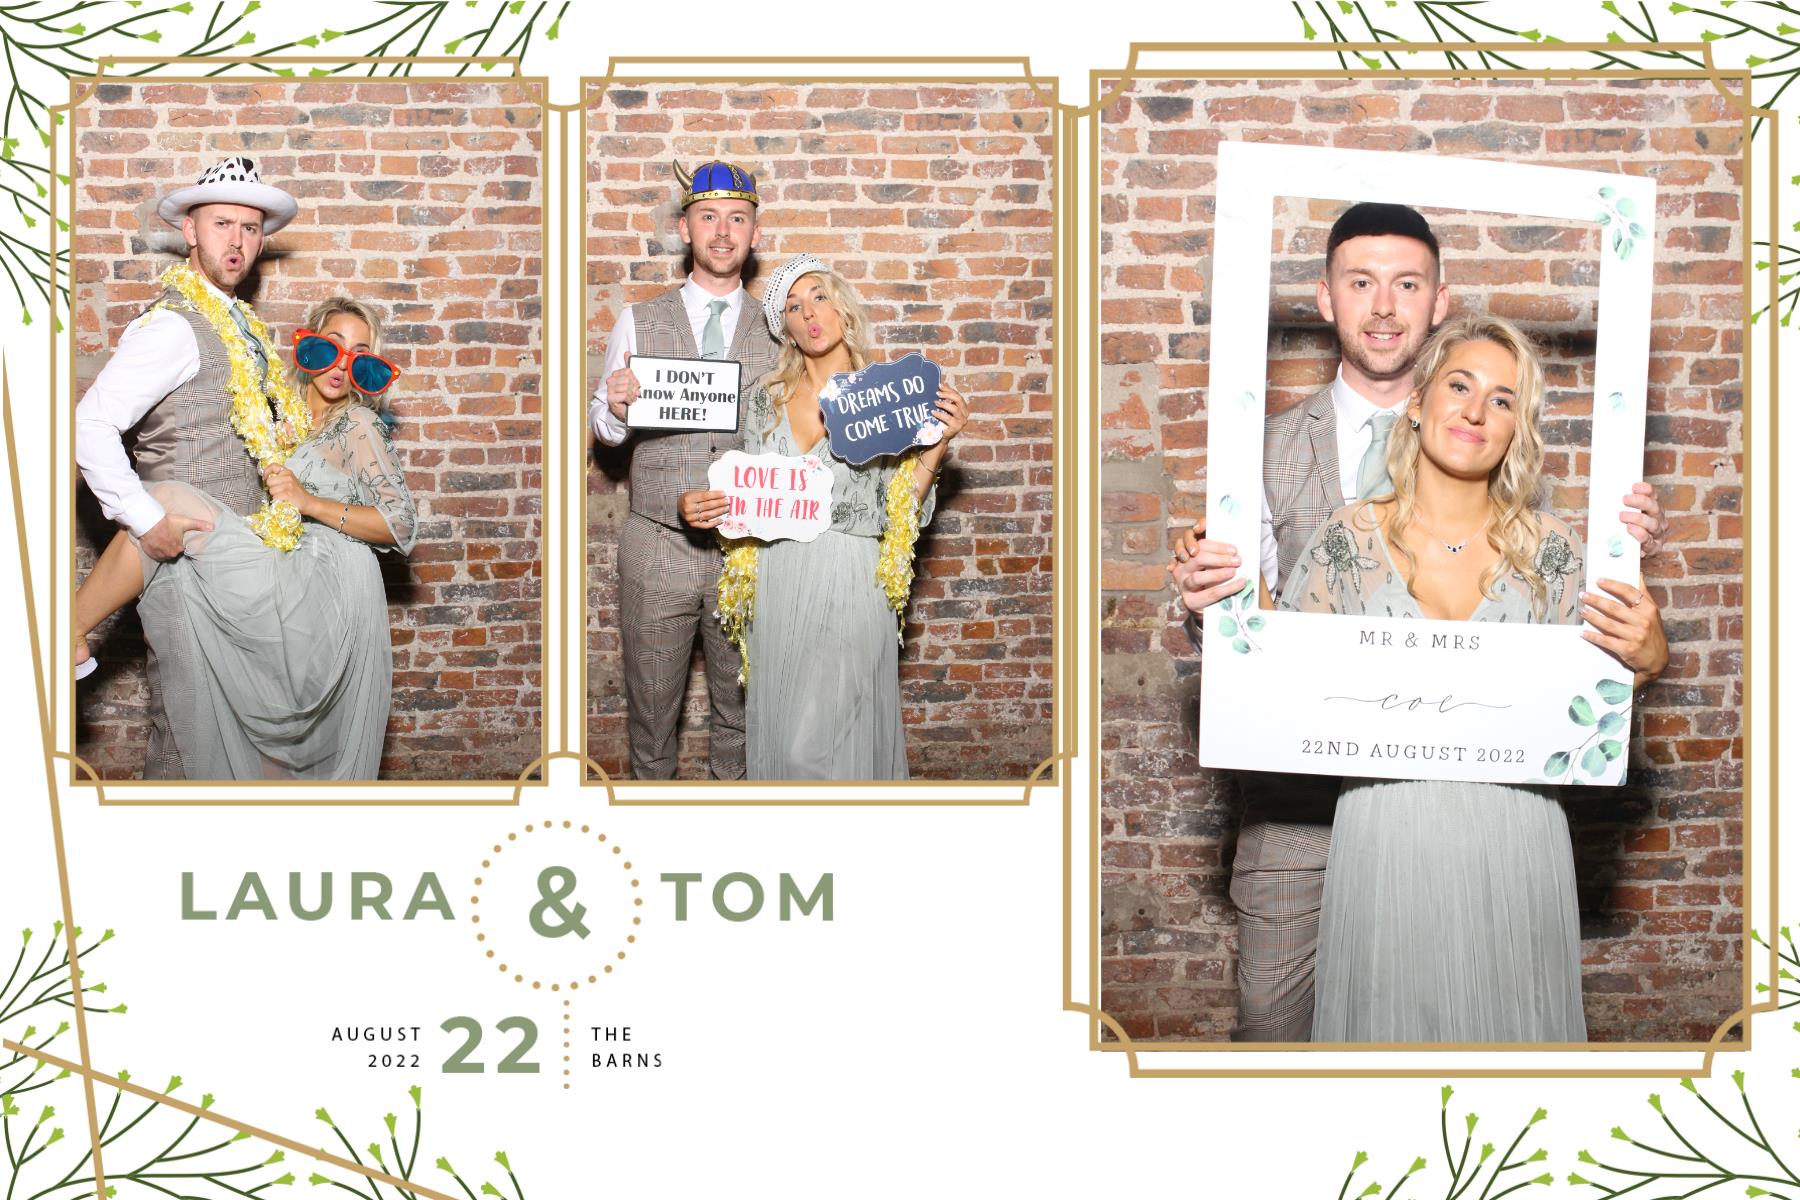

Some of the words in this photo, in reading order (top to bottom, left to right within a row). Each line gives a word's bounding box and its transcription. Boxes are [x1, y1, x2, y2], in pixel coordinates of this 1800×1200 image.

[655, 369, 661, 383] I
[666, 370, 715, 386] DON'T
[638, 388, 675, 401] now
[680, 388, 736, 405] Anyone
[837, 381, 900, 415] DREAMS
[902, 375, 925, 396] DO
[659, 406, 707, 422] HERE!
[845, 414, 890, 441] COME
[892, 402, 932, 430] TRUE
[734, 465, 781, 490] LOVE
[789, 468, 808, 492] IS
[755, 497, 784, 519] THE
[790, 499, 820, 521] AIR
[1359, 630, 1393, 646] MR
[1405, 632, 1419, 648] &
[1432, 634, 1481, 650] MRS
[1301, 739, 1360, 756] 22ND
[1369, 743, 1467, 762] AUGUST
[1476, 748, 1526, 764] 2022
